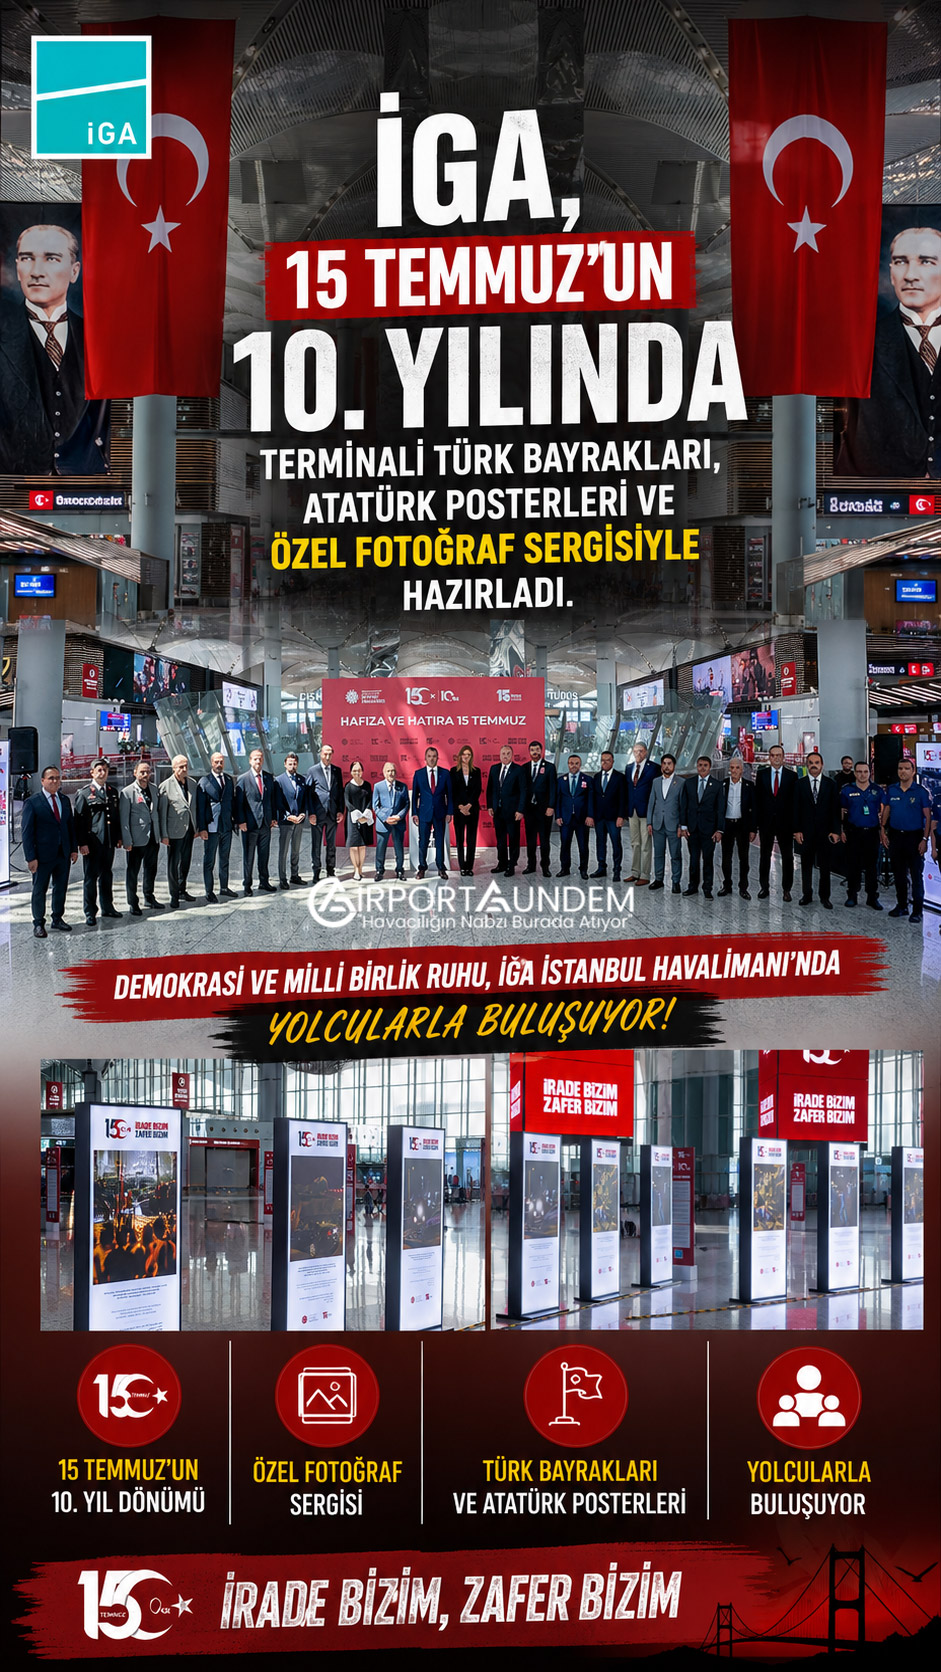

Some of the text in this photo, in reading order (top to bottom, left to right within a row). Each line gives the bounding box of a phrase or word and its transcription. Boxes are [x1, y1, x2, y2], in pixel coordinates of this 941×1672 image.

[340, 715, 527, 727] HAFIZA VE HATIRA 15 TEMMUZ
[543, 1096, 582, 1114] ZAFER
[793, 1108, 826, 1123] ZAFER
